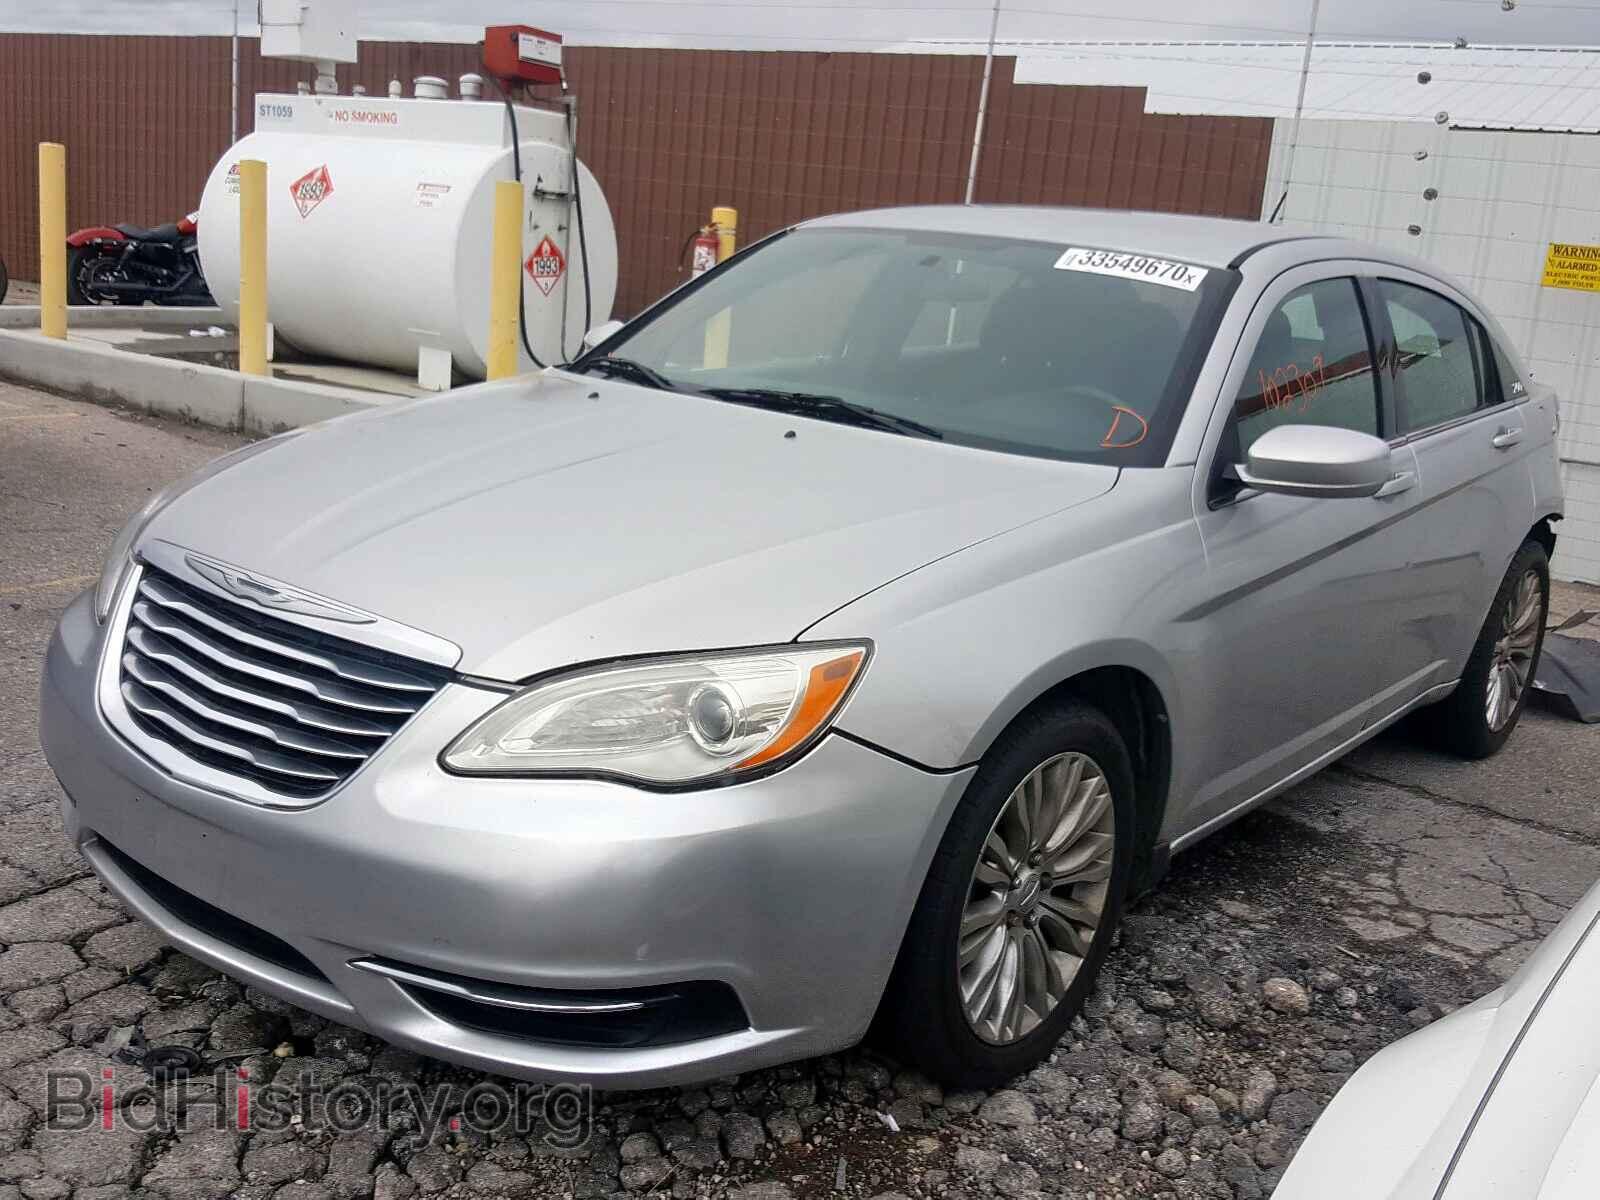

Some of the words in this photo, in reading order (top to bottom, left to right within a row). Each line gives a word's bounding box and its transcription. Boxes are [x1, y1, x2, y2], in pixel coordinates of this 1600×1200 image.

[259, 105, 293, 118] ST1059
[335, 110, 349, 121] NO
[351, 111, 398, 124] SMOKING
[1553, 244, 1600, 259] WARNIN
[534, 257, 558, 274] 1993
[1099, 406, 1148, 448] D
